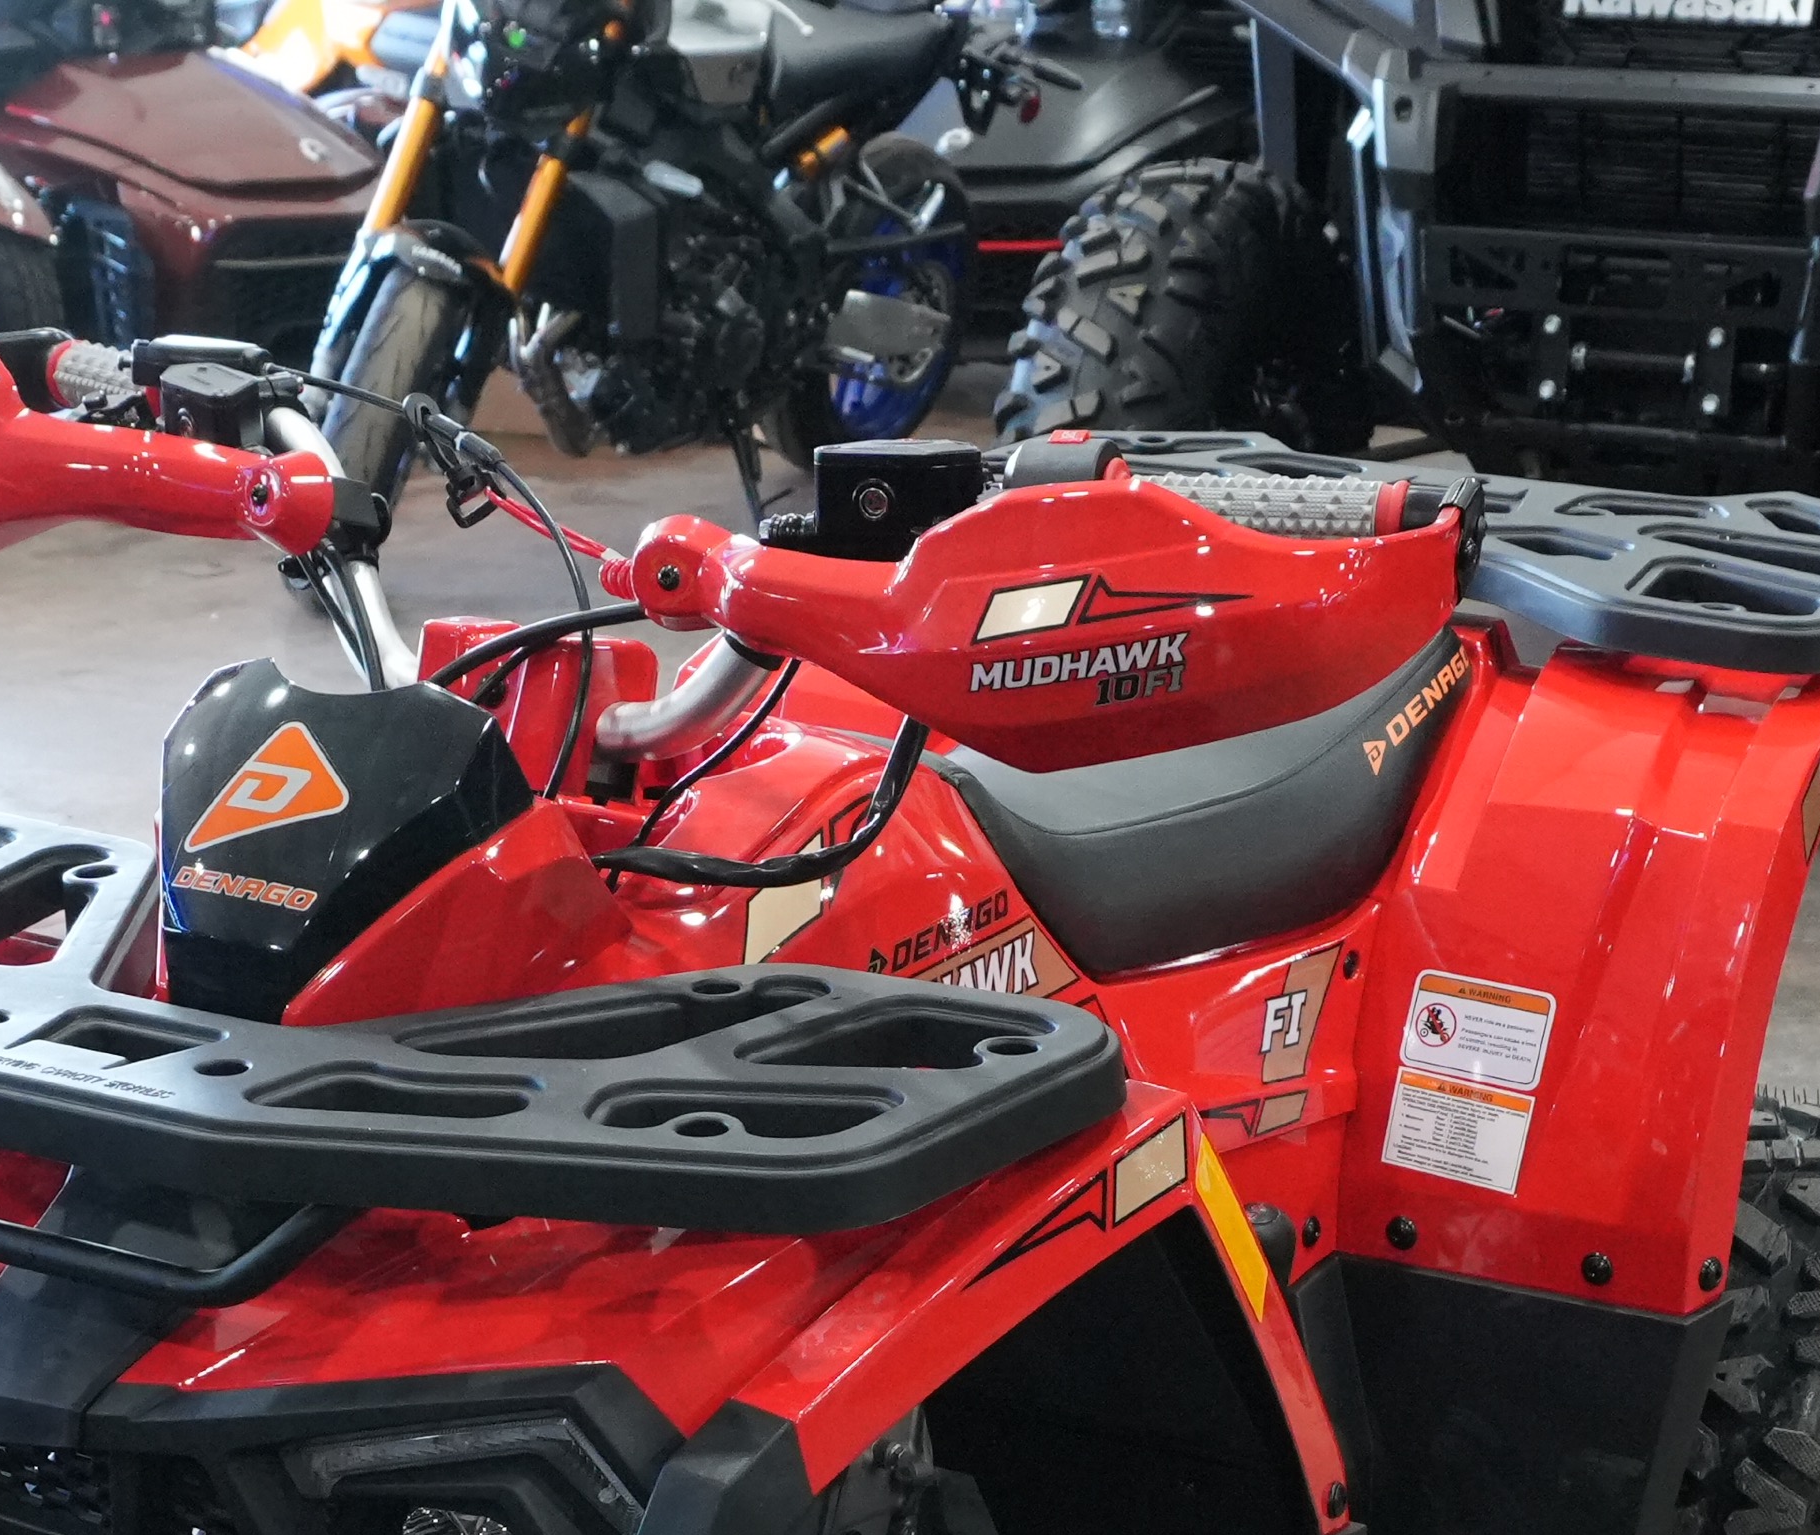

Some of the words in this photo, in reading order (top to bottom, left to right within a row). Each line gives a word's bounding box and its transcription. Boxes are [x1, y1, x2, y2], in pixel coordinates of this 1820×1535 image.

[969, 630, 1191, 693] MUDHAWK
[170, 865, 318, 911] DENAGO
[940, 927, 1040, 995] AWK
[1259, 988, 1308, 1055] FI
[1468, 988, 1512, 1004] WARNING
